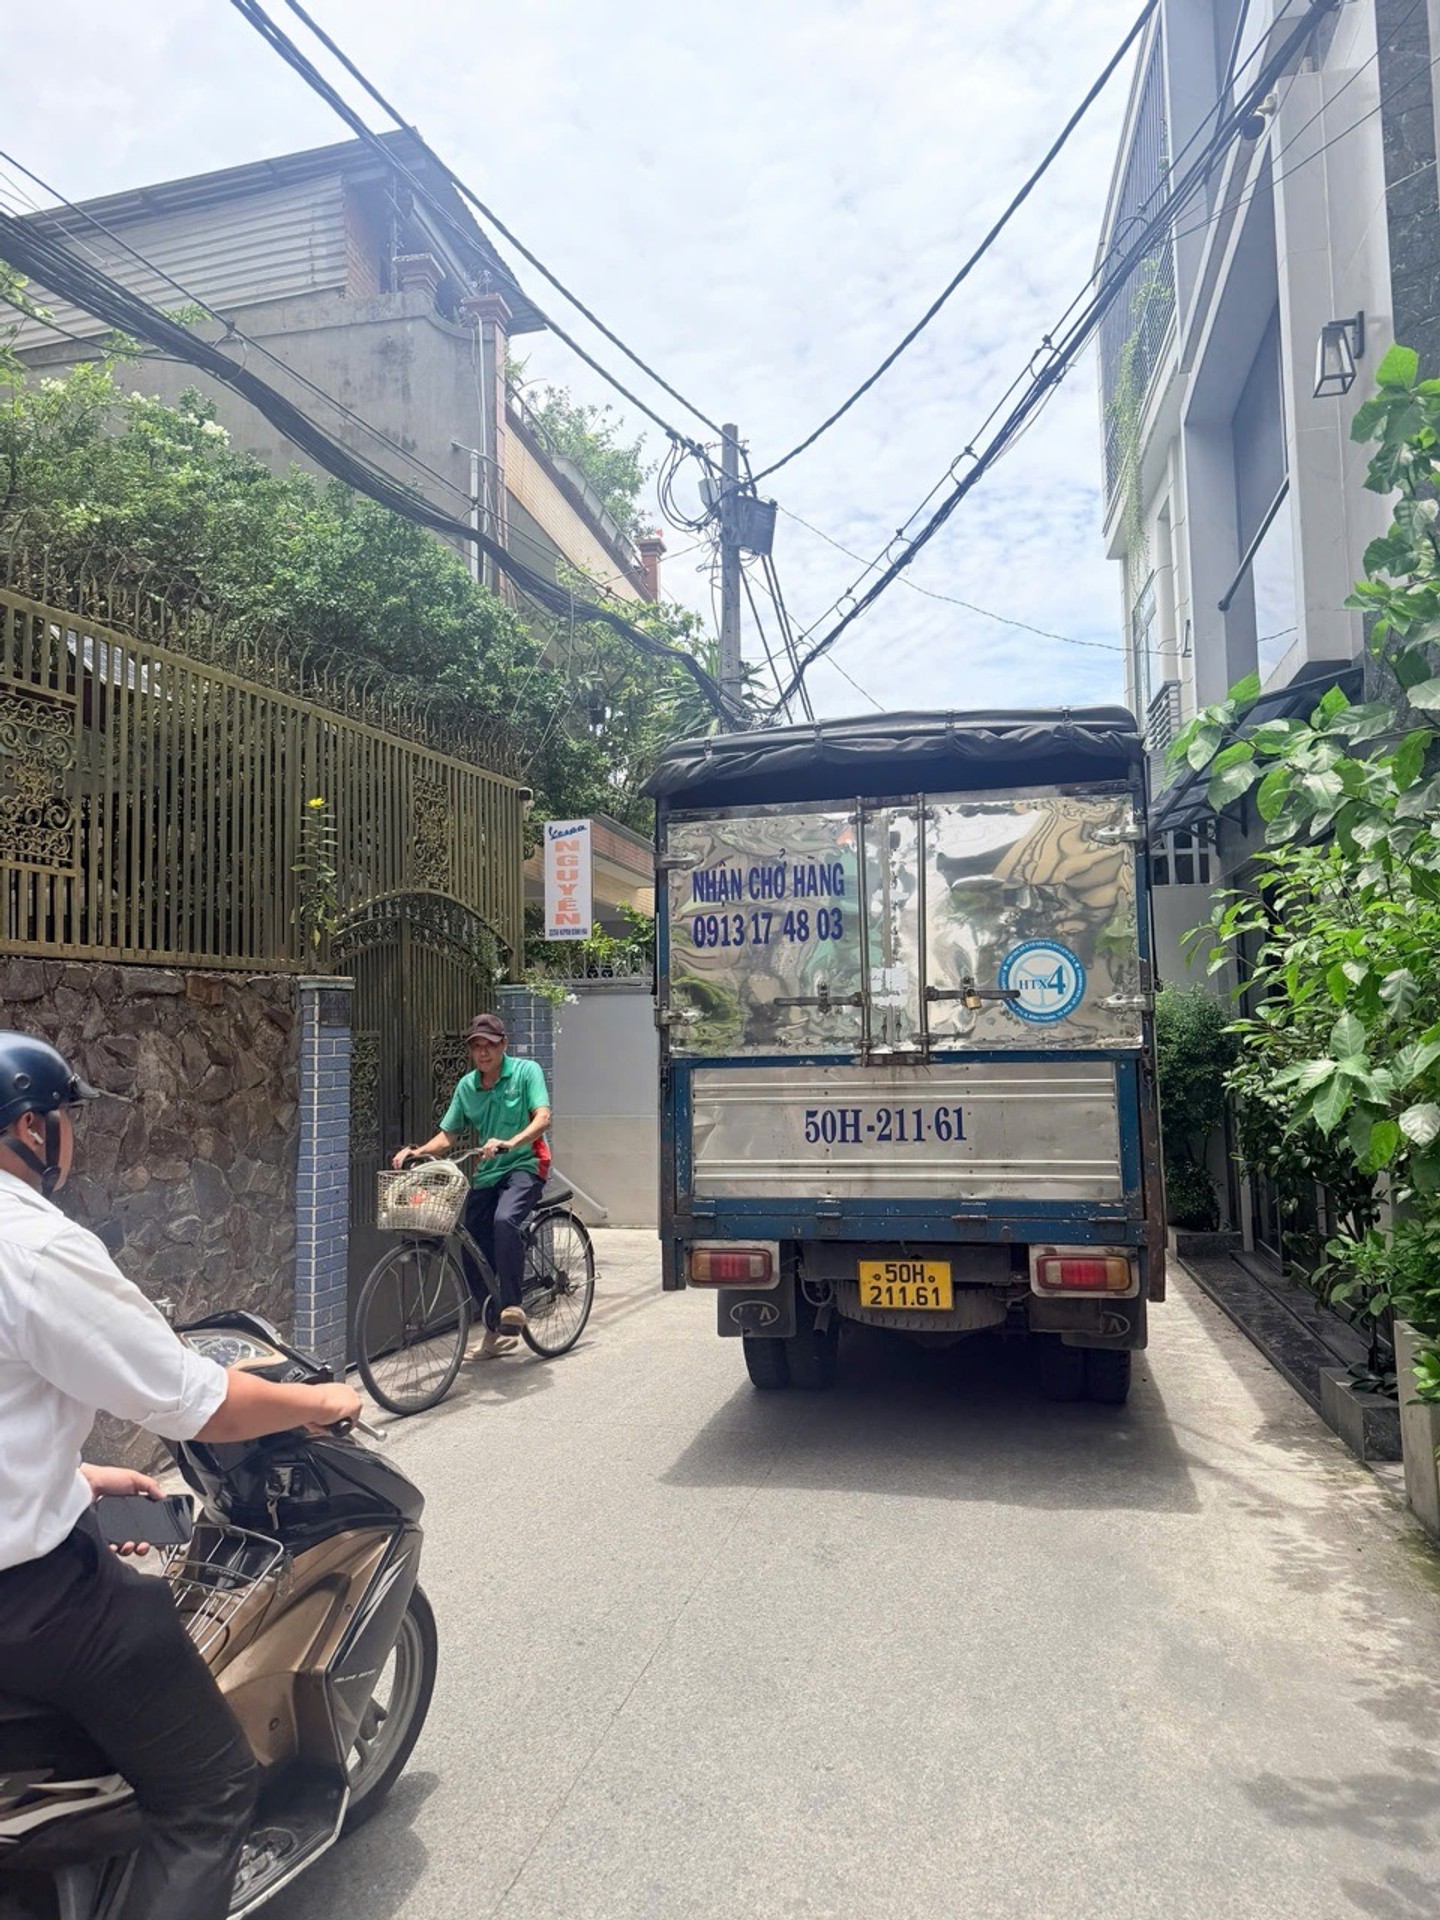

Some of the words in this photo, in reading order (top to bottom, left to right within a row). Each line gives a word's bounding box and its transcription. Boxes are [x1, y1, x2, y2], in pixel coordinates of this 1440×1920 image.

[692, 860, 743, 907] NHẬN
[748, 848, 788, 900] CHỞ
[793, 856, 845, 898] HÀNG
[693, 914, 746, 949] 0913
[751, 911, 774, 945] 17
[783, 910, 810, 942] 48
[817, 907, 844, 942] 03
[884, 1263, 925, 1283] 50H
[869, 1285, 941, 1307] 211.61
